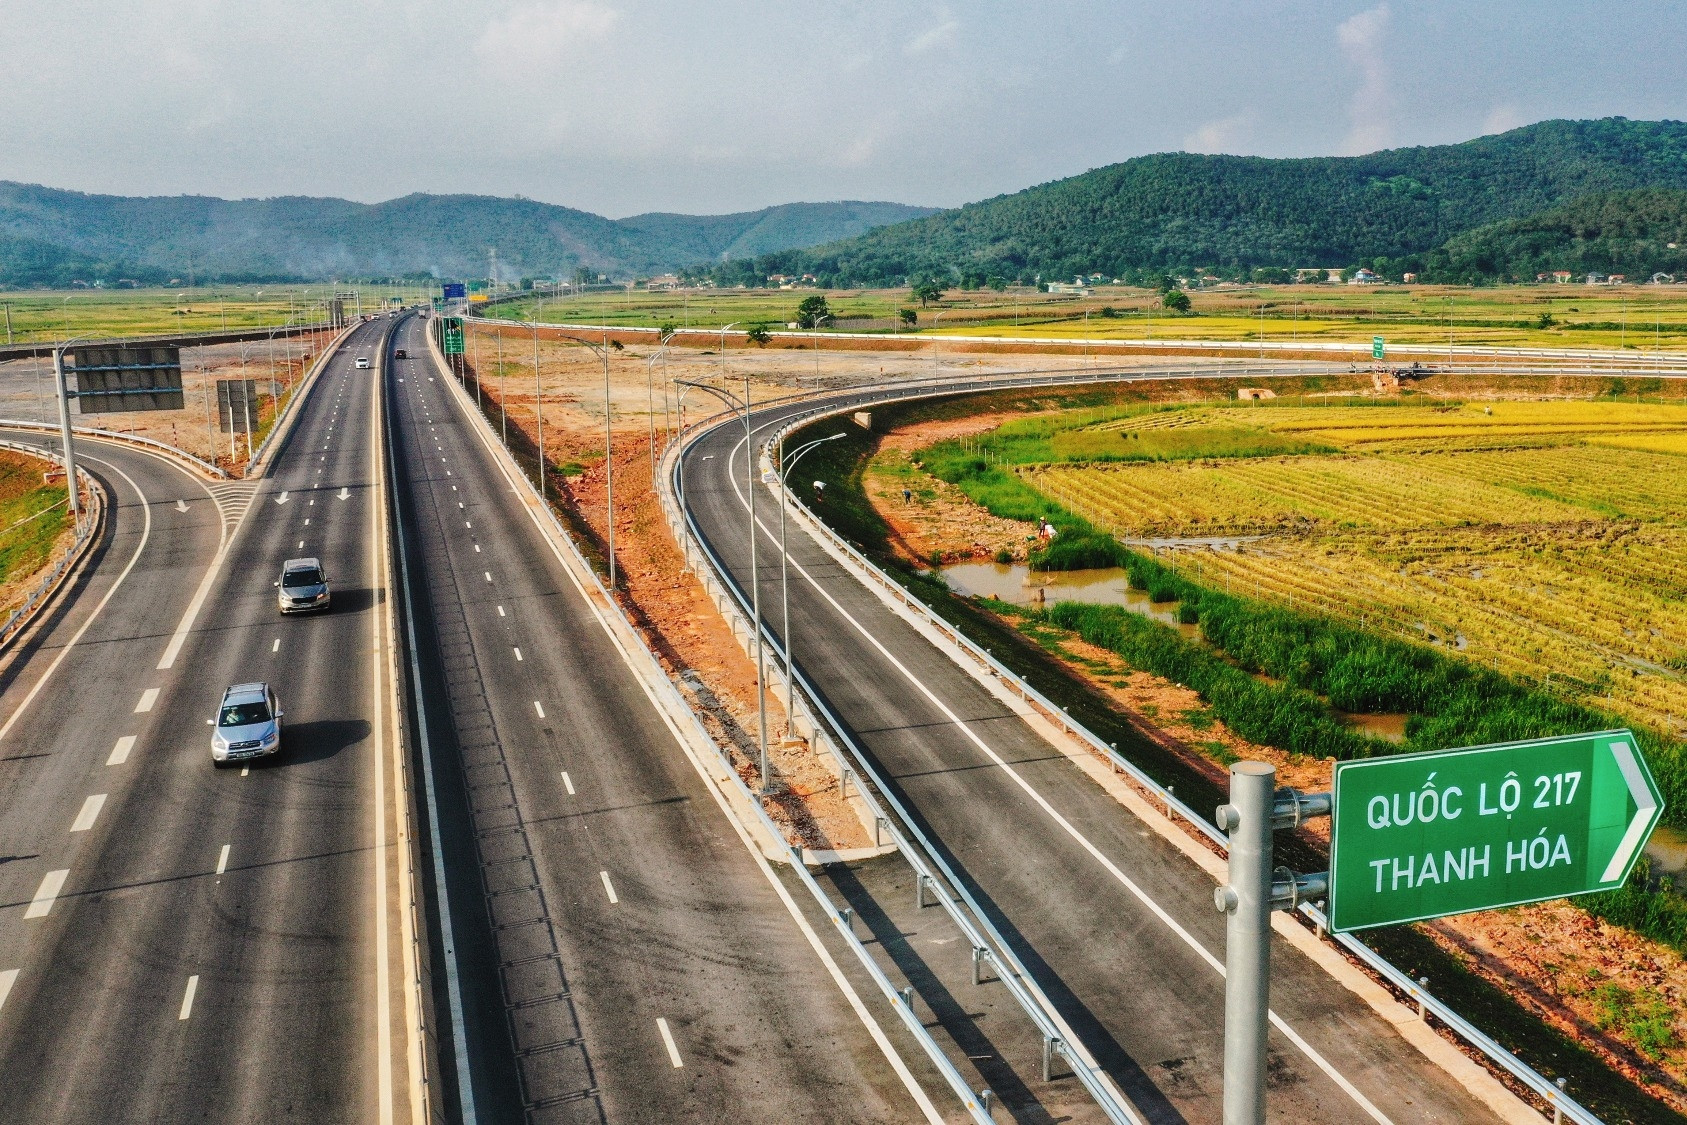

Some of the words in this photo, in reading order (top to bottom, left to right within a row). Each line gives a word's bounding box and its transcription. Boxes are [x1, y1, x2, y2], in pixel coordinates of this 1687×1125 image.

[1366, 771, 1464, 830] QUỐC
[1479, 771, 1522, 820] LỘ
[1533, 771, 1582, 810] 217
[1369, 844, 1491, 893] THANH
[1505, 826, 1572, 874] HÓA
